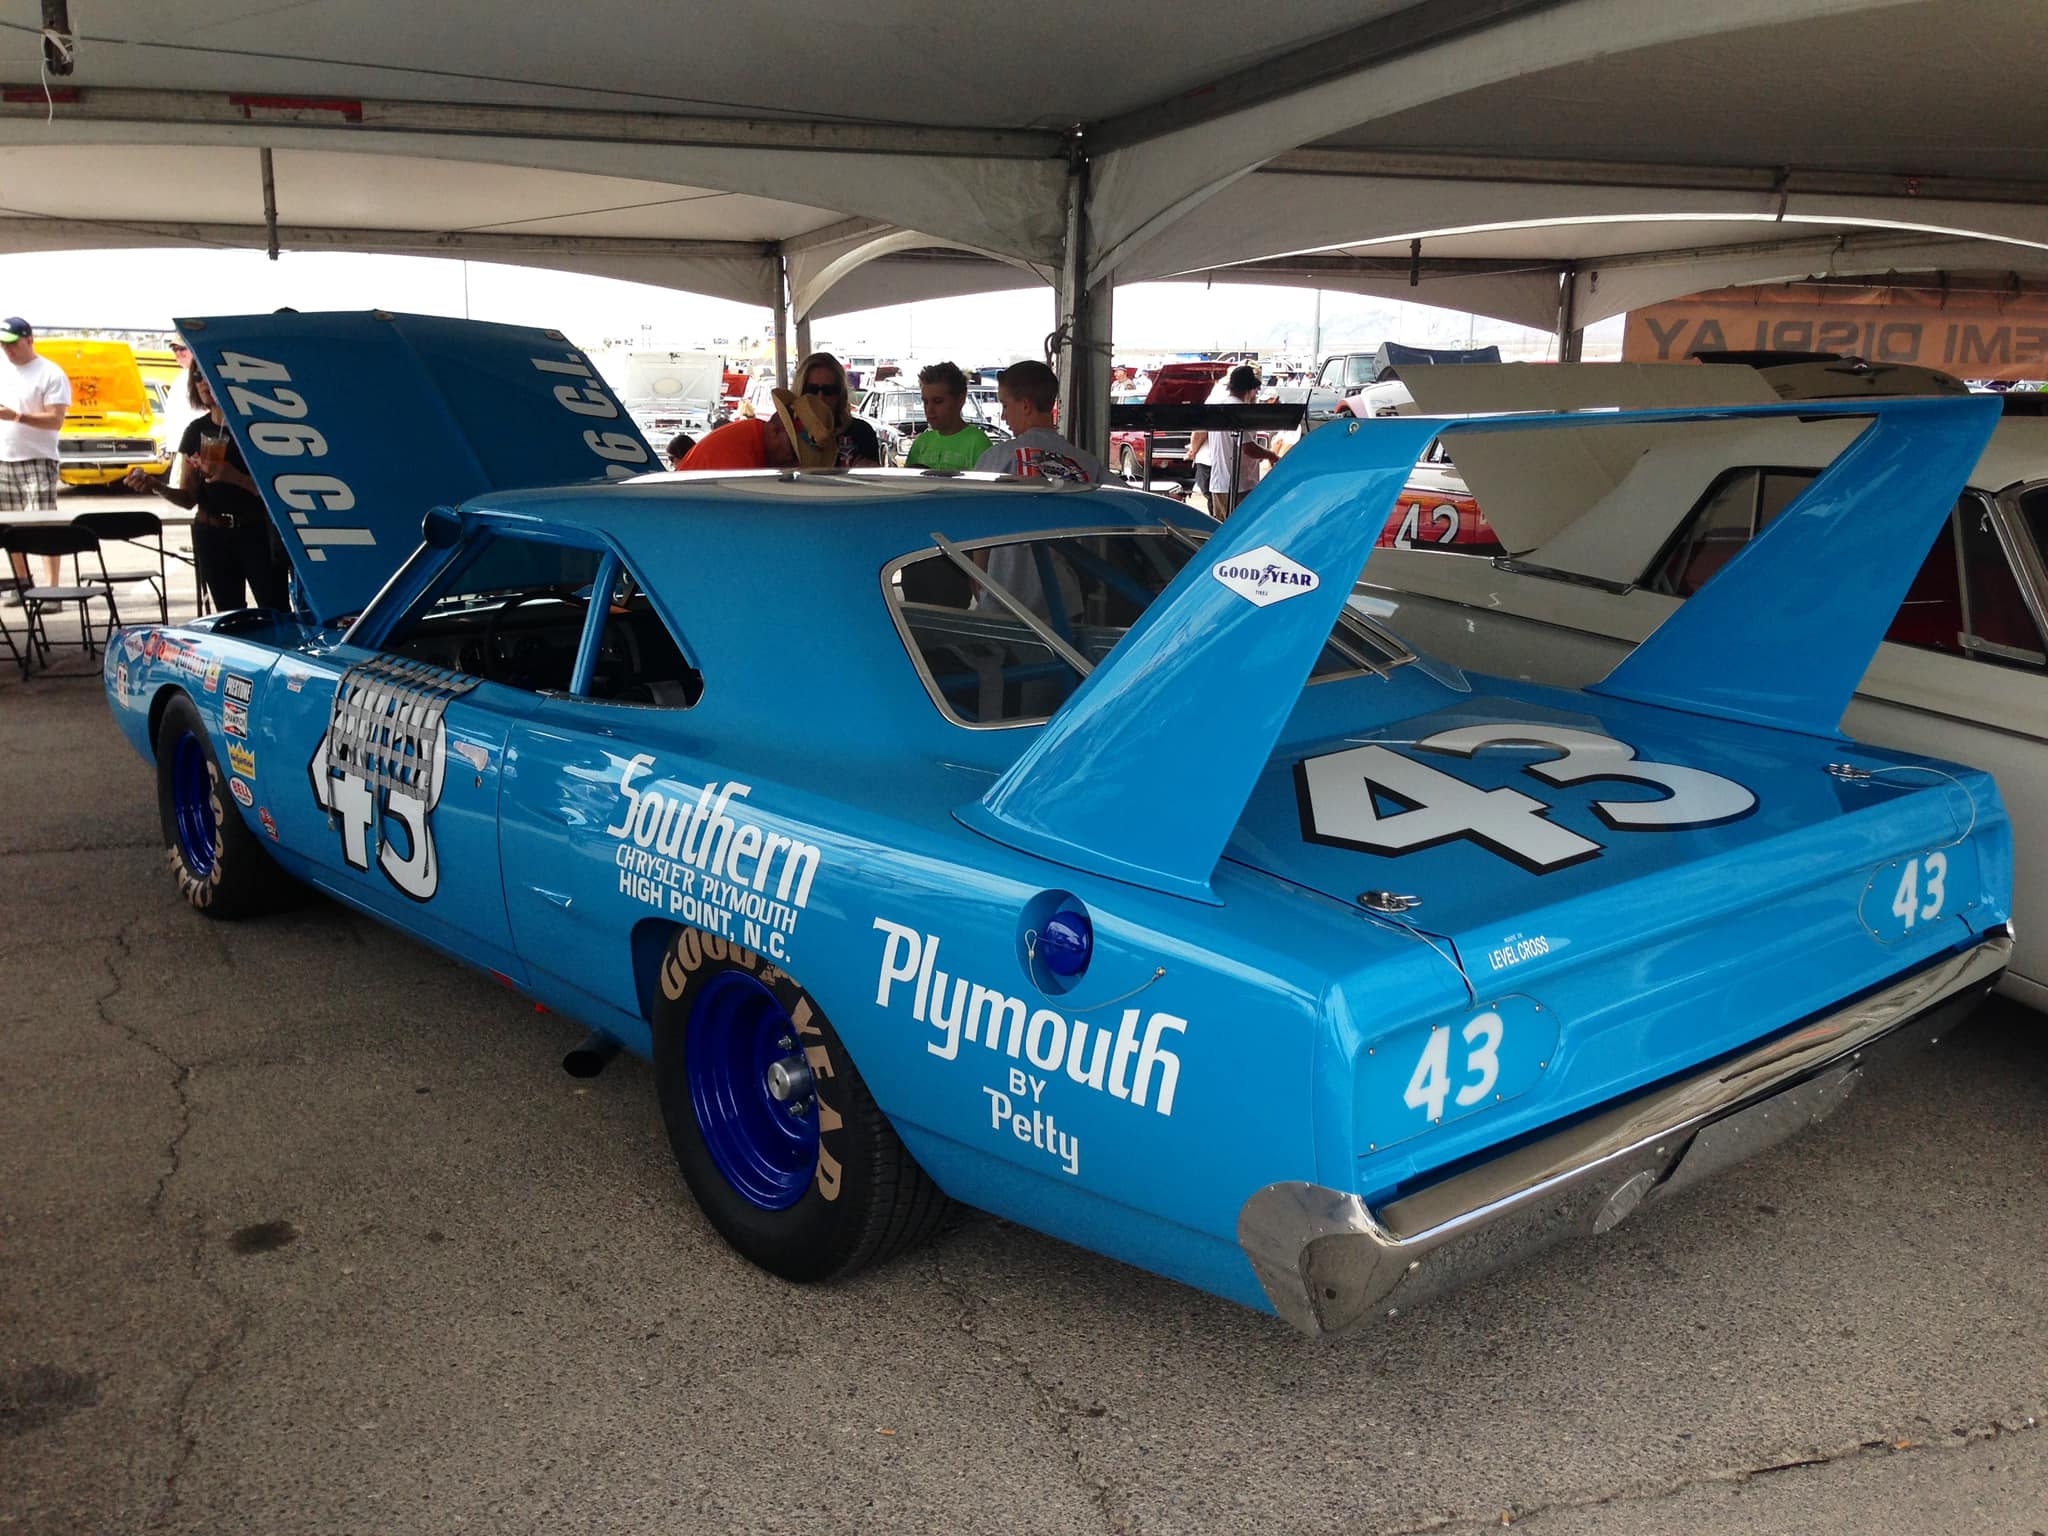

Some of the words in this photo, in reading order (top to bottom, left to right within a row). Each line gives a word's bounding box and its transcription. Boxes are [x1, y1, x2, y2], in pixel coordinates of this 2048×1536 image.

[530, 353, 619, 418] C.I.
[216, 351, 328, 457] 426
[274, 474, 377, 561] C.I.
[1393, 502, 1459, 549] 42
[231, 780, 252, 800] BELL
[607, 753, 821, 908] Southern
[1294, 723, 1760, 876] 43
[615, 843, 695, 893] CHRYSLER
[701, 874, 798, 934] PLYMOUTH
[619, 870, 663, 908] HIGH
[670, 892, 735, 942] POINT,
[744, 920, 791, 963] N.C.
[1892, 851, 1947, 929] 43
[1488, 945, 1520, 971] LEVEL
[1517, 935, 1549, 960] CROSS
[873, 917, 1188, 1116] Plymouth
[1009, 1067, 1047, 1103] BY
[1403, 1012, 1504, 1122] 43
[983, 1086, 1079, 1175] Petty
